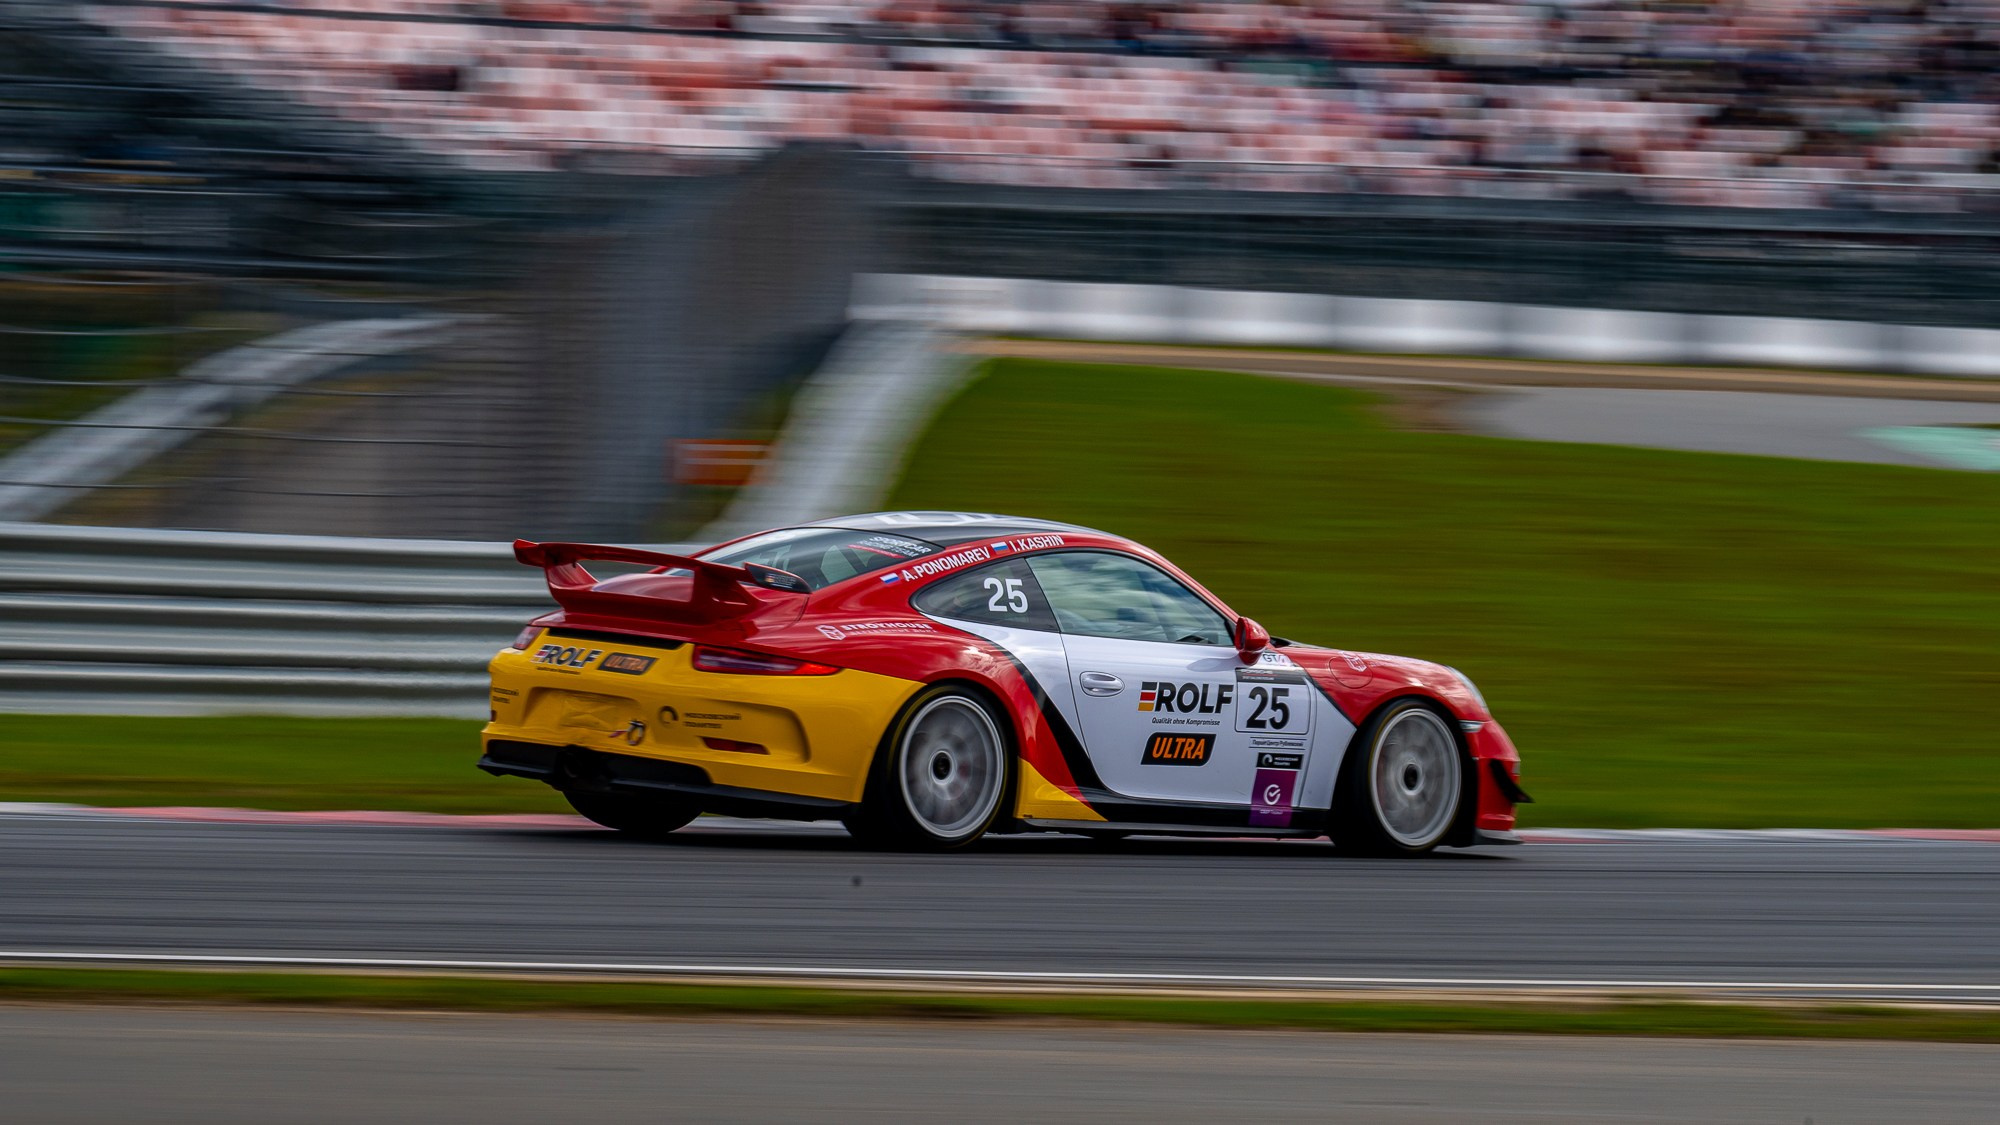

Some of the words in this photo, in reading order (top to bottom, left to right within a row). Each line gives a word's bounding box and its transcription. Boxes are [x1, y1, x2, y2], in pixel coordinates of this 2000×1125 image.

[1008, 534, 1065, 552] I.KASHIN
[901, 547, 991, 582] A.PONOMAREV
[983, 577, 1029, 614] 25
[542, 645, 604, 668] ROLF
[604, 653, 649, 672] ULTRA
[1154, 681, 1234, 714] ROLF
[1245, 685, 1290, 730] 25
[1151, 717, 1173, 725] Qualität
[1186, 718, 1221, 726] Kompromisse
[1152, 737, 1206, 759] ULTRA
